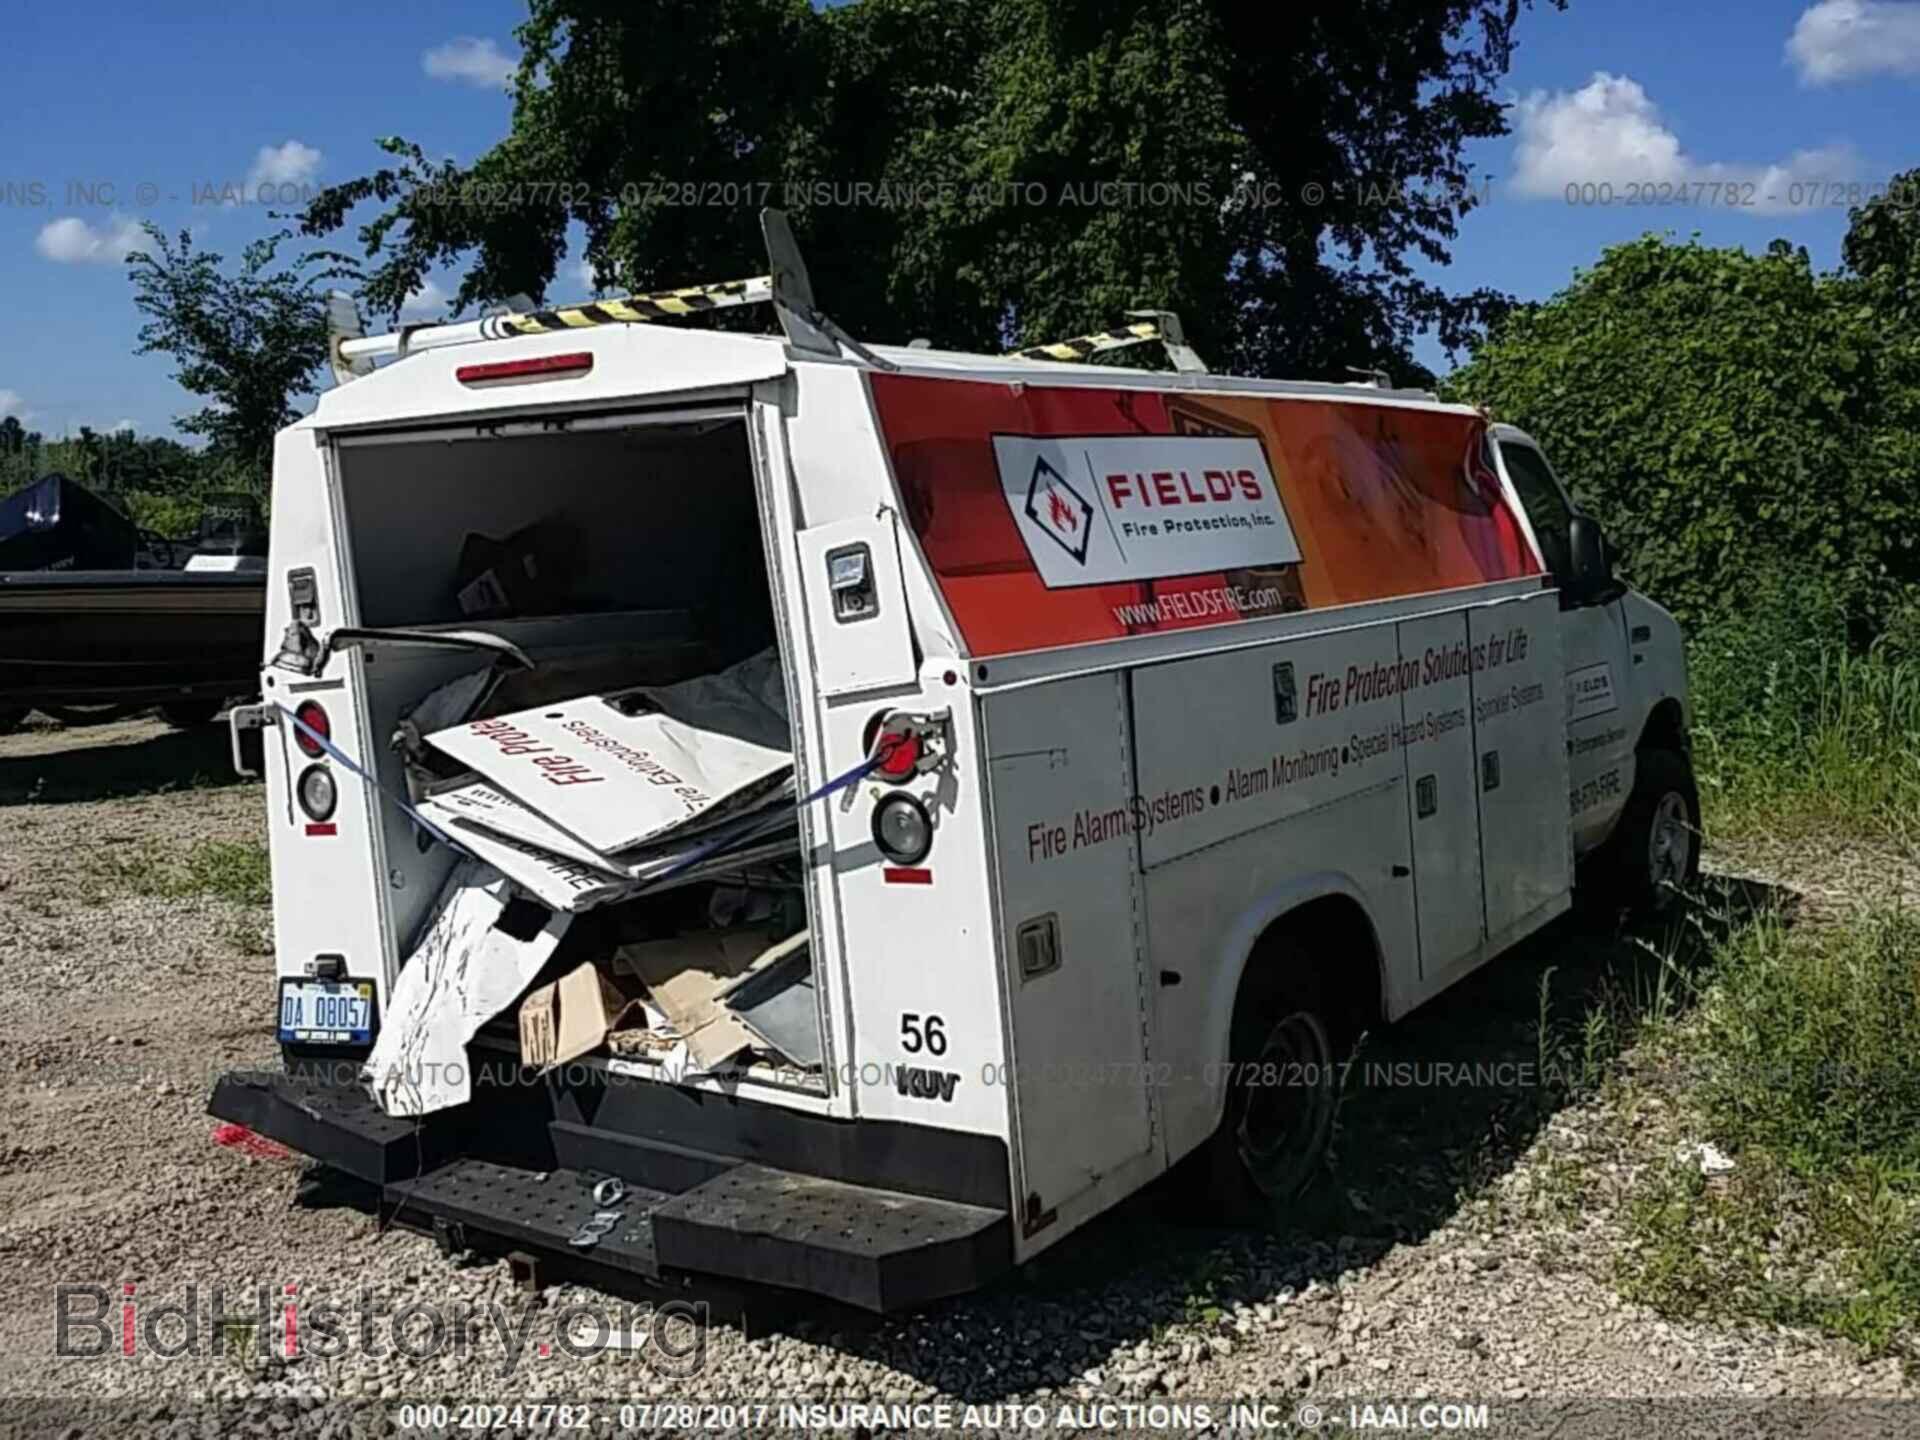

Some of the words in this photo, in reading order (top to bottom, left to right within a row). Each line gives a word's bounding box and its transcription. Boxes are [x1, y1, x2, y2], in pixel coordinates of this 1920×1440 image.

[1106, 469, 1263, 509] FIELD'S
[1121, 522, 1159, 537] Fire
[1112, 585, 1282, 626] www.FIELDSFIRE.com
[1305, 672, 1342, 717] Fire
[1344, 655, 1420, 706] Protecion
[1488, 633, 1506, 669] for
[1506, 627, 1529, 664] Life
[532, 755, 605, 786] Fire
[562, 719, 683, 787] Extinguishers
[1027, 821, 1067, 863] Fire
[1072, 811, 1126, 851] Alarm
[1131, 784, 1205, 834] Systems
[1226, 764, 1269, 803] Alarm
[1272, 743, 1340, 784] Monitoring
[1390, 712, 1426, 751] Hzard
[284, 996, 303, 1026] DA
[316, 996, 370, 1027] 08057
[901, 1013, 947, 1056] 56
[896, 1065, 962, 1103] KUV
